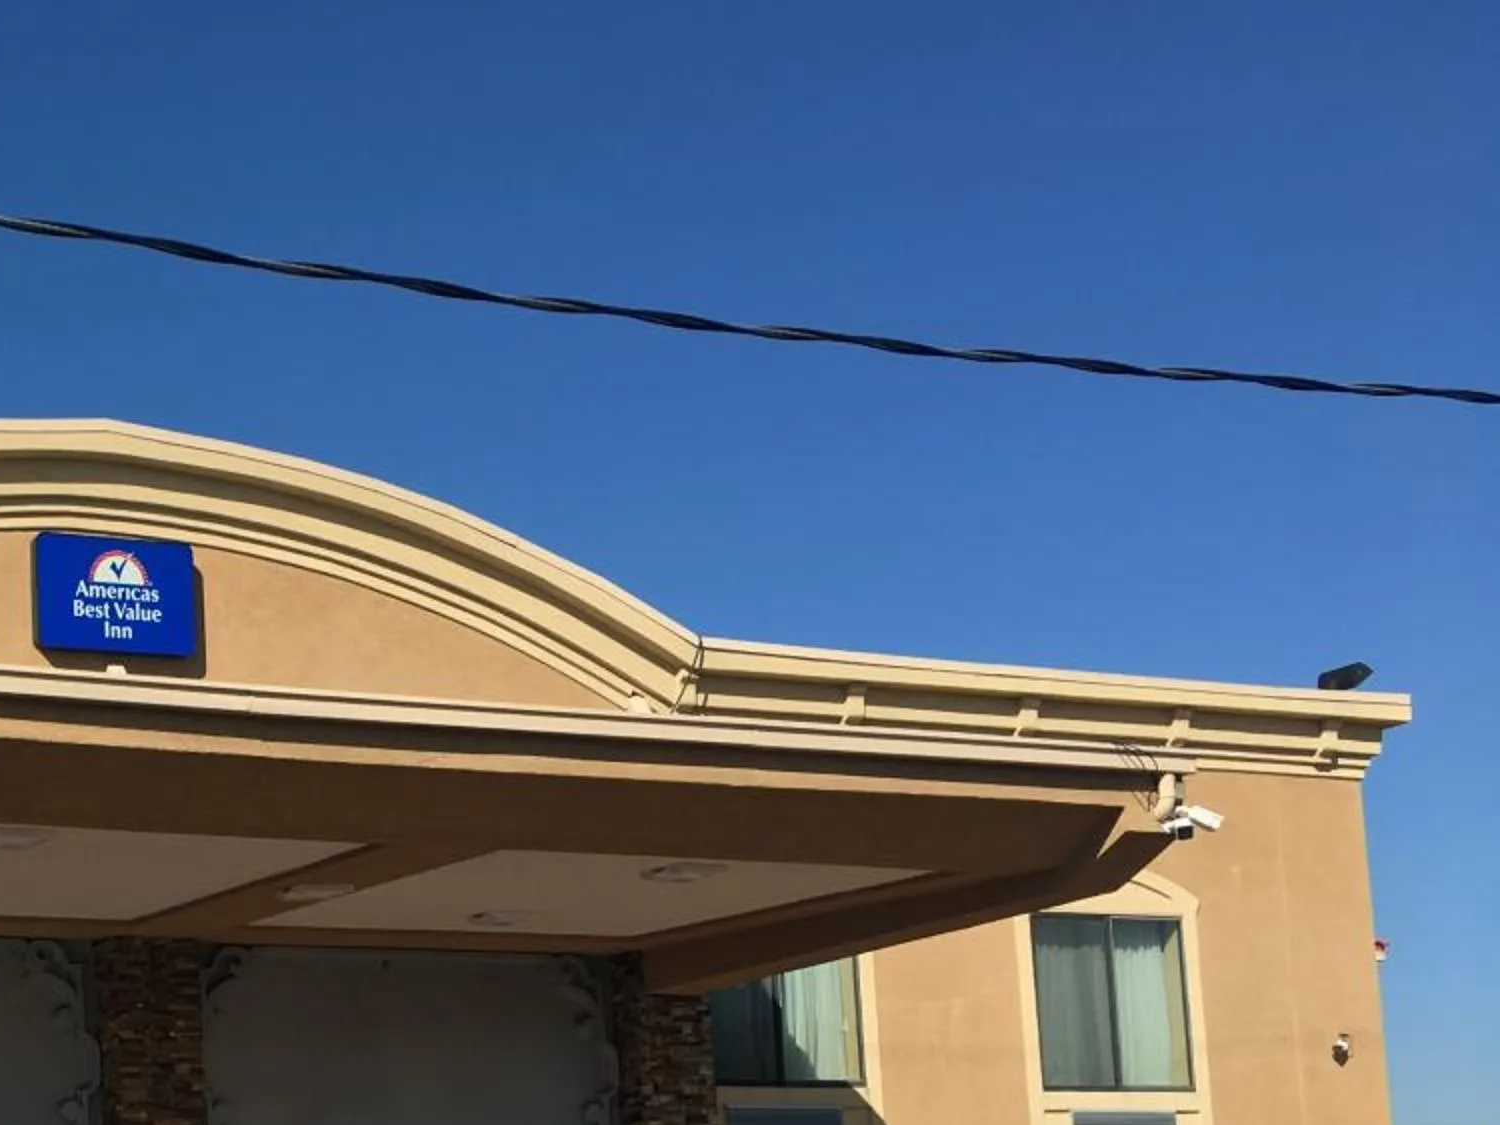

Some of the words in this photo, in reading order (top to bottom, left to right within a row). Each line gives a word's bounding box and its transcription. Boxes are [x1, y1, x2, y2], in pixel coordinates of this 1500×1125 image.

[75, 580, 160, 602] Americas
[73, 599, 110, 619] Best
[114, 602, 162, 623] Value
[104, 621, 133, 639] Inn
